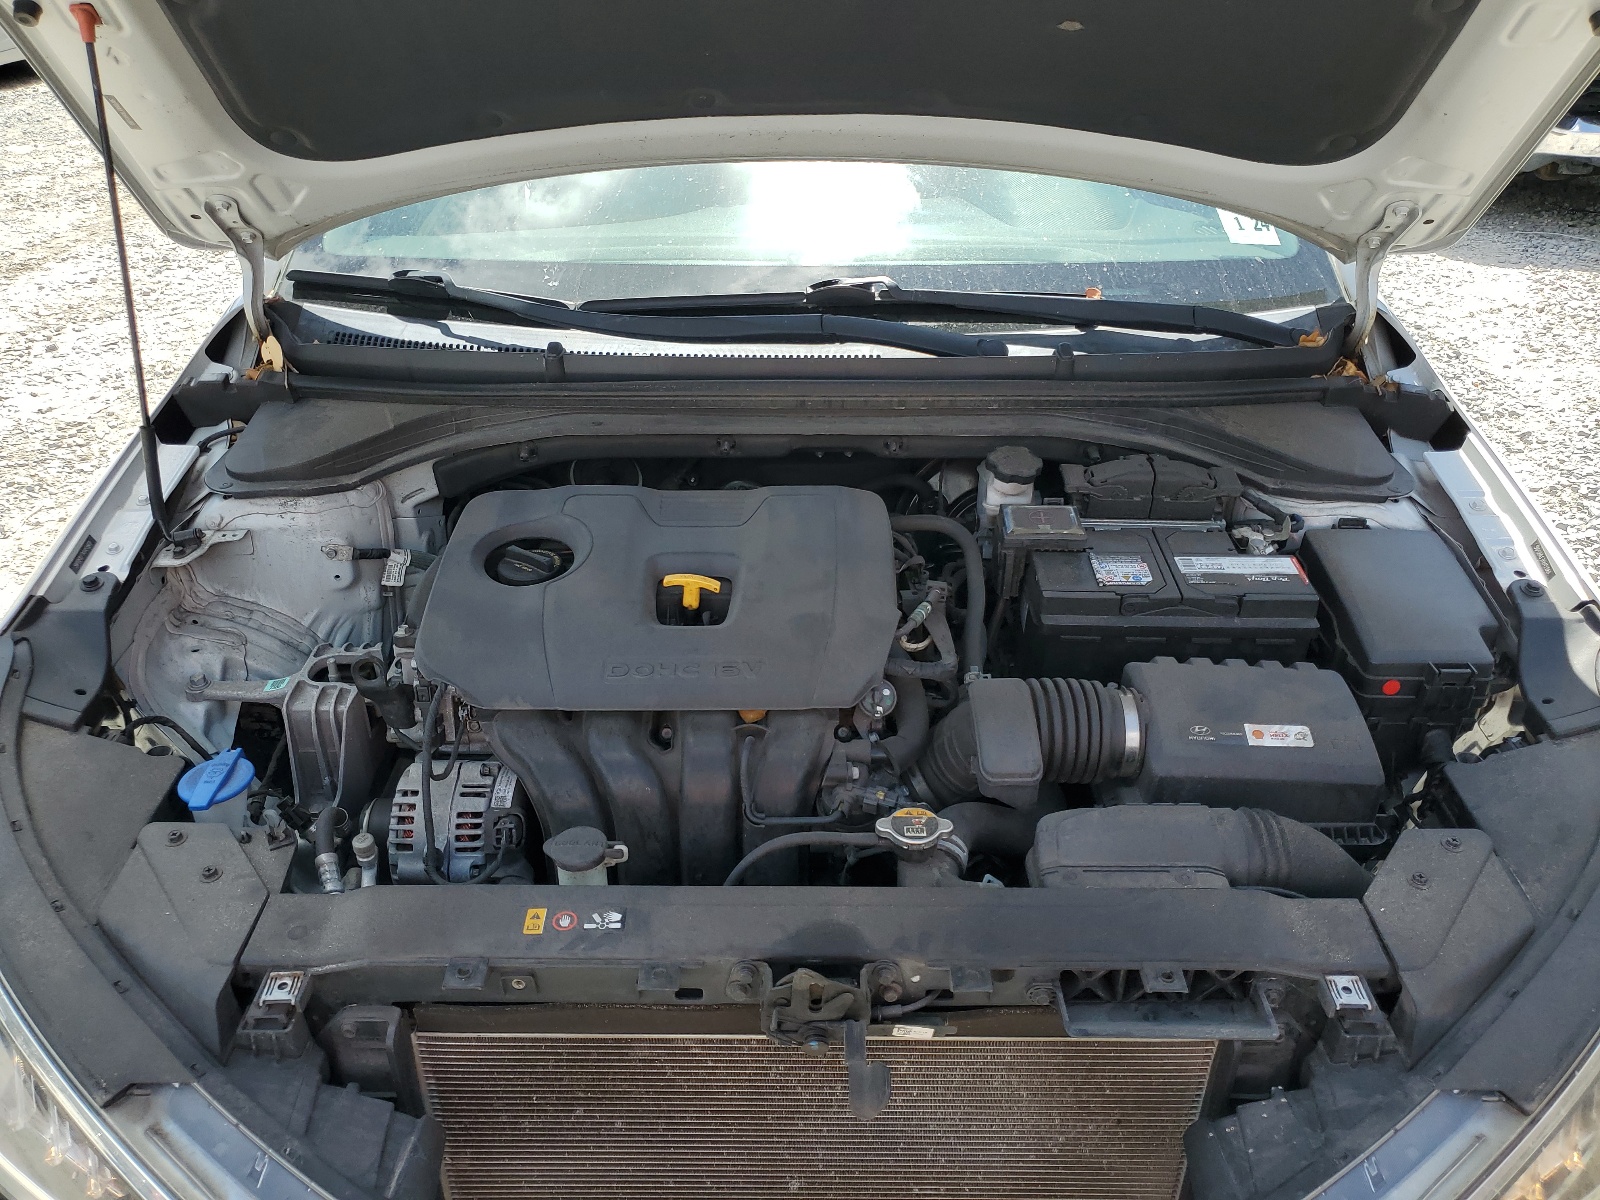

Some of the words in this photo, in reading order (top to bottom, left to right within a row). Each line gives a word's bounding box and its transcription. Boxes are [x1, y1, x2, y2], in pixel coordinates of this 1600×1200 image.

[606, 662, 701, 679] DOHC
[712, 661, 765, 679] 16V
[554, 839, 604, 847] COOLANT
